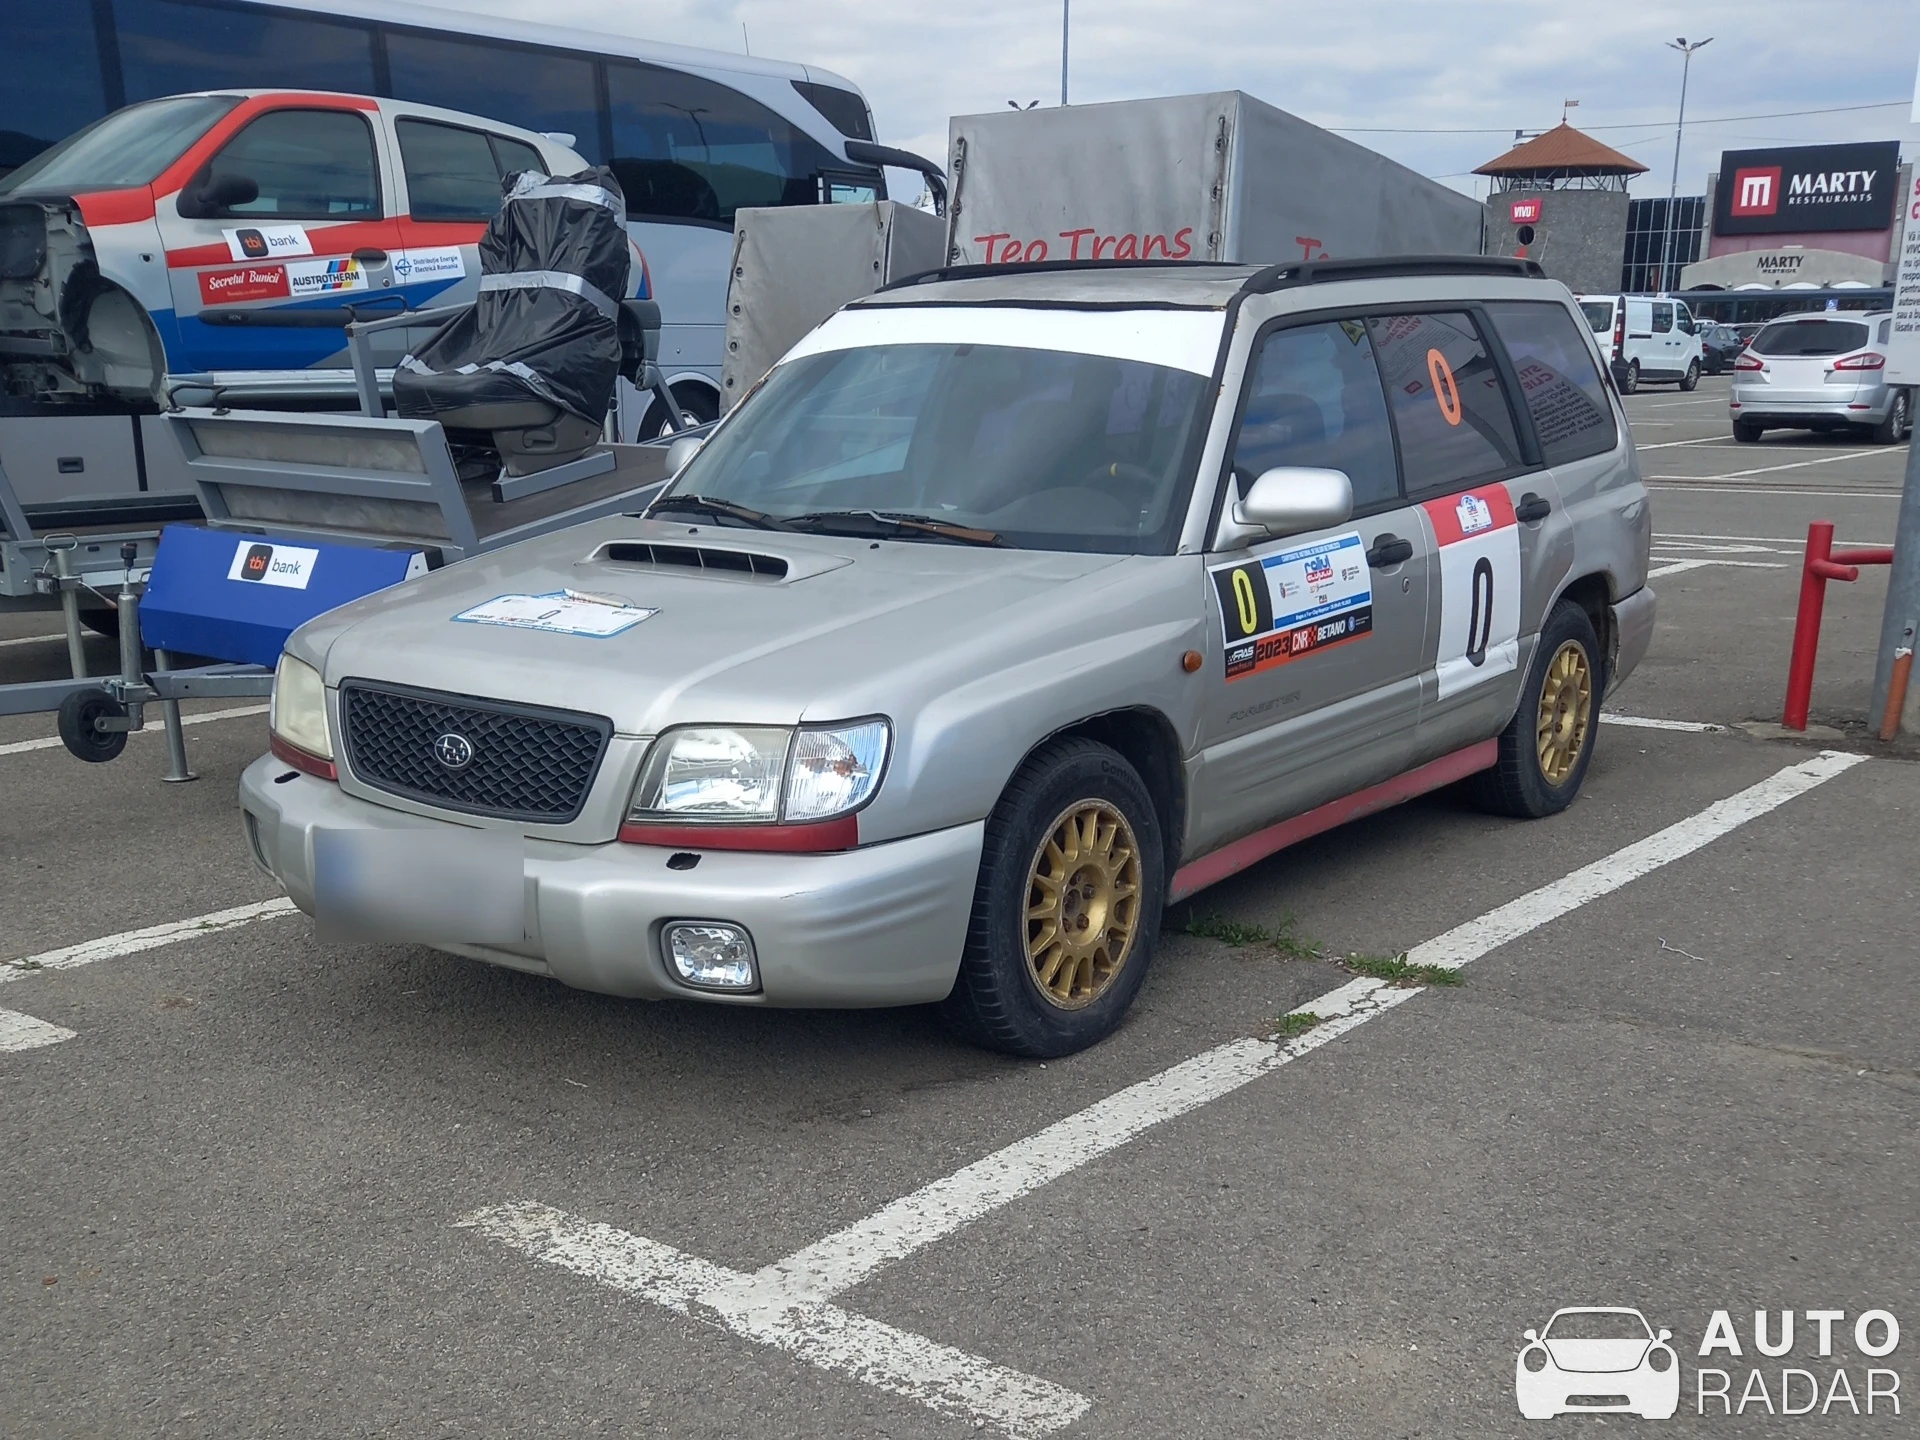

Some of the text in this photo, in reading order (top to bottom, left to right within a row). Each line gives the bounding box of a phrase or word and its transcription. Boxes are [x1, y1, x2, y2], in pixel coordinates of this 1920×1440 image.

[1788, 170, 1877, 195] MARTY
[1788, 193, 1873, 205] RESTAURANTS
[1514, 206, 1535, 218] VIVO!
[245, 235, 298, 249] tbi bank
[973, 228, 1192, 264] Teo Trans
[1757, 256, 1804, 269] MARTY
[1903, 260, 1912, 268] nu
[209, 270, 280, 290] Secretul Bunicii
[292, 271, 360, 287] AUSTROTHERM
[1896, 312, 1908, 320] sau
[249, 556, 301, 575] tbi bank
[1232, 568, 1257, 634] 0
[1256, 637, 1290, 662] 2023
[1292, 630, 1308, 651] CNR
[1317, 620, 1346, 642] BETANO
